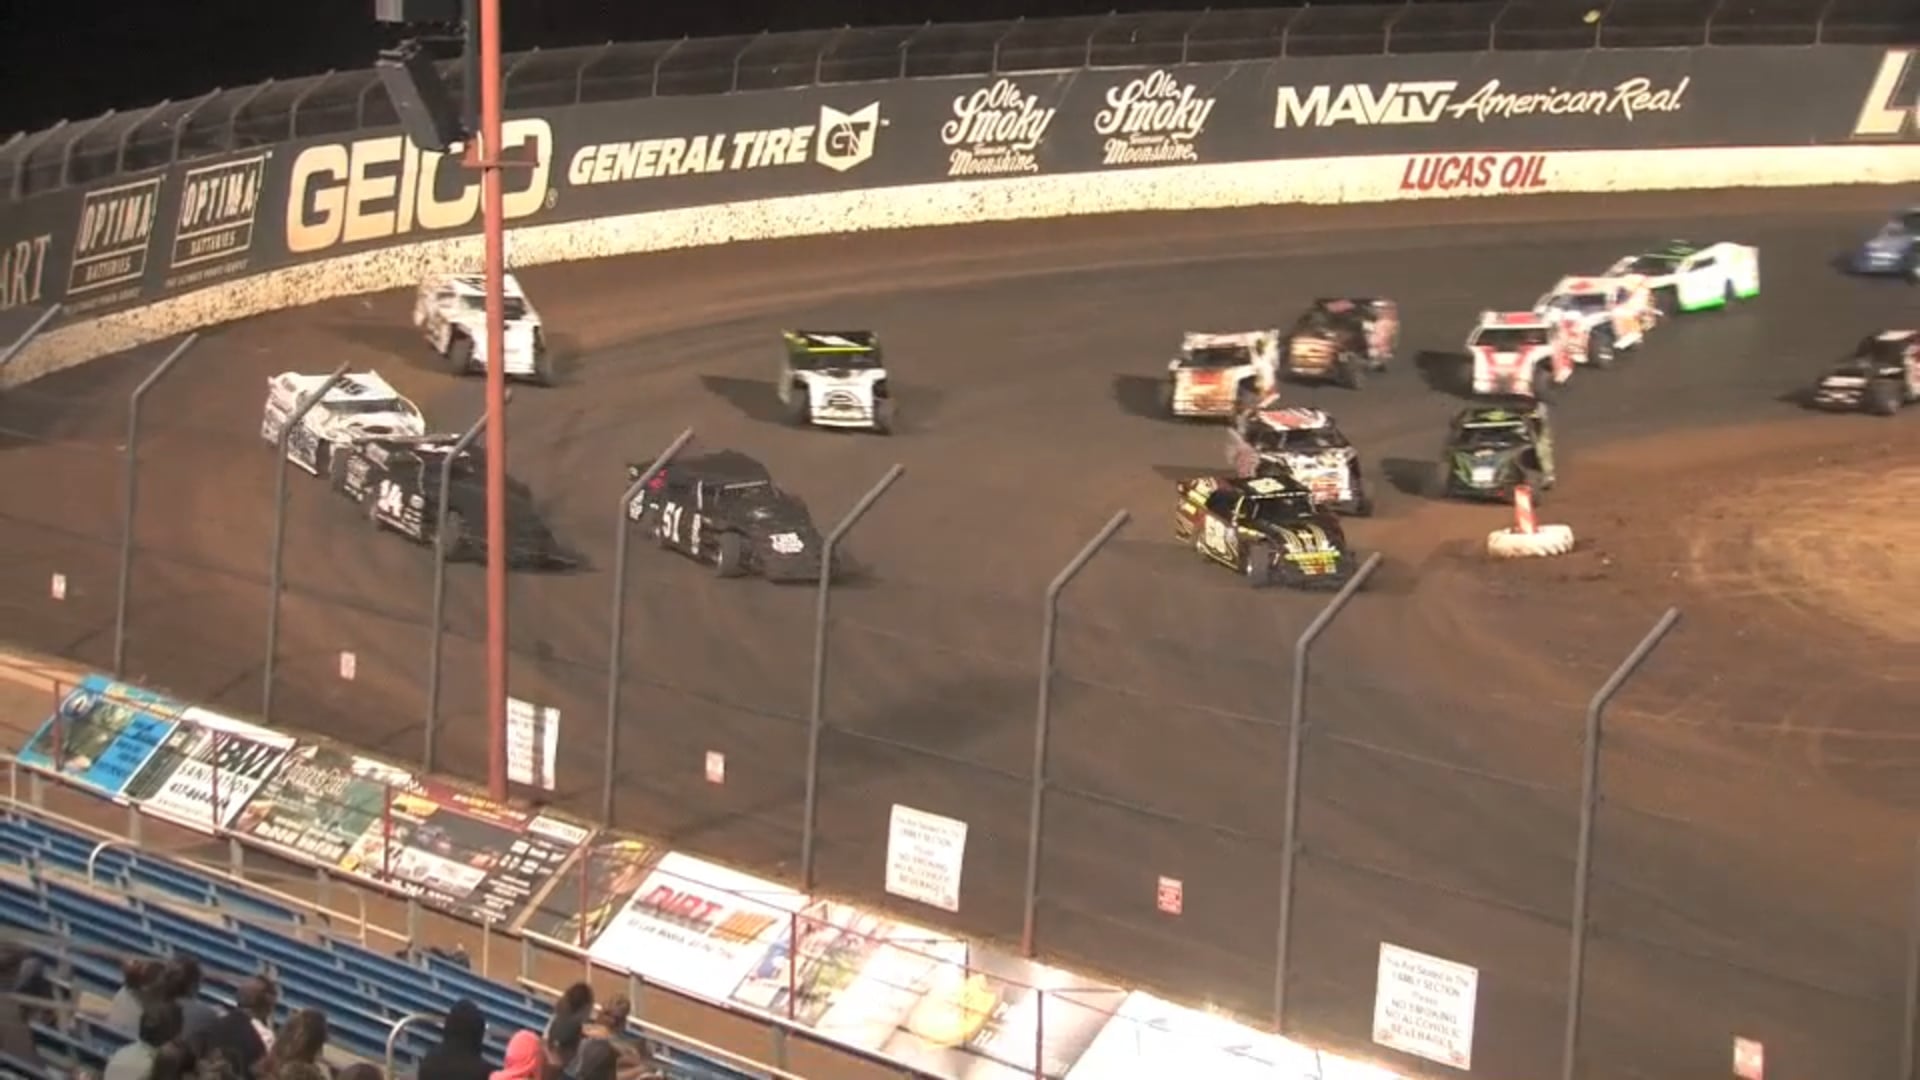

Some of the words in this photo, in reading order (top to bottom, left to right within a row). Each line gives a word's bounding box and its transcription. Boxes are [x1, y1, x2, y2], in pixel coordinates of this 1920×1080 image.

[989, 79, 1025, 108] Ole
[1143, 69, 1181, 99] Ole
[1274, 81, 1458, 128] MAVTV
[1446, 78, 1606, 123] American
[1610, 76, 1690, 121] Real.
[1853, 50, 1920, 136] L
[941, 89, 1055, 150] Smoky
[1094, 80, 1216, 138] Smoky
[568, 134, 726, 185] GENERAL
[730, 126, 815, 170] TIRE
[947, 149, 1039, 176] Moonshine
[1103, 138, 1198, 165] Moonshine
[1400, 156, 1496, 191] LUCAS
[1500, 156, 1548, 188] OIL
[182, 170, 256, 228] OPTIMA
[287, 118, 553, 252] GEICO
[80, 193, 153, 252] OPTIMA
[191, 230, 236, 256] BATTERIES
[86, 256, 131, 282] BATTERIES
[645, 885, 723, 922] DIRT
